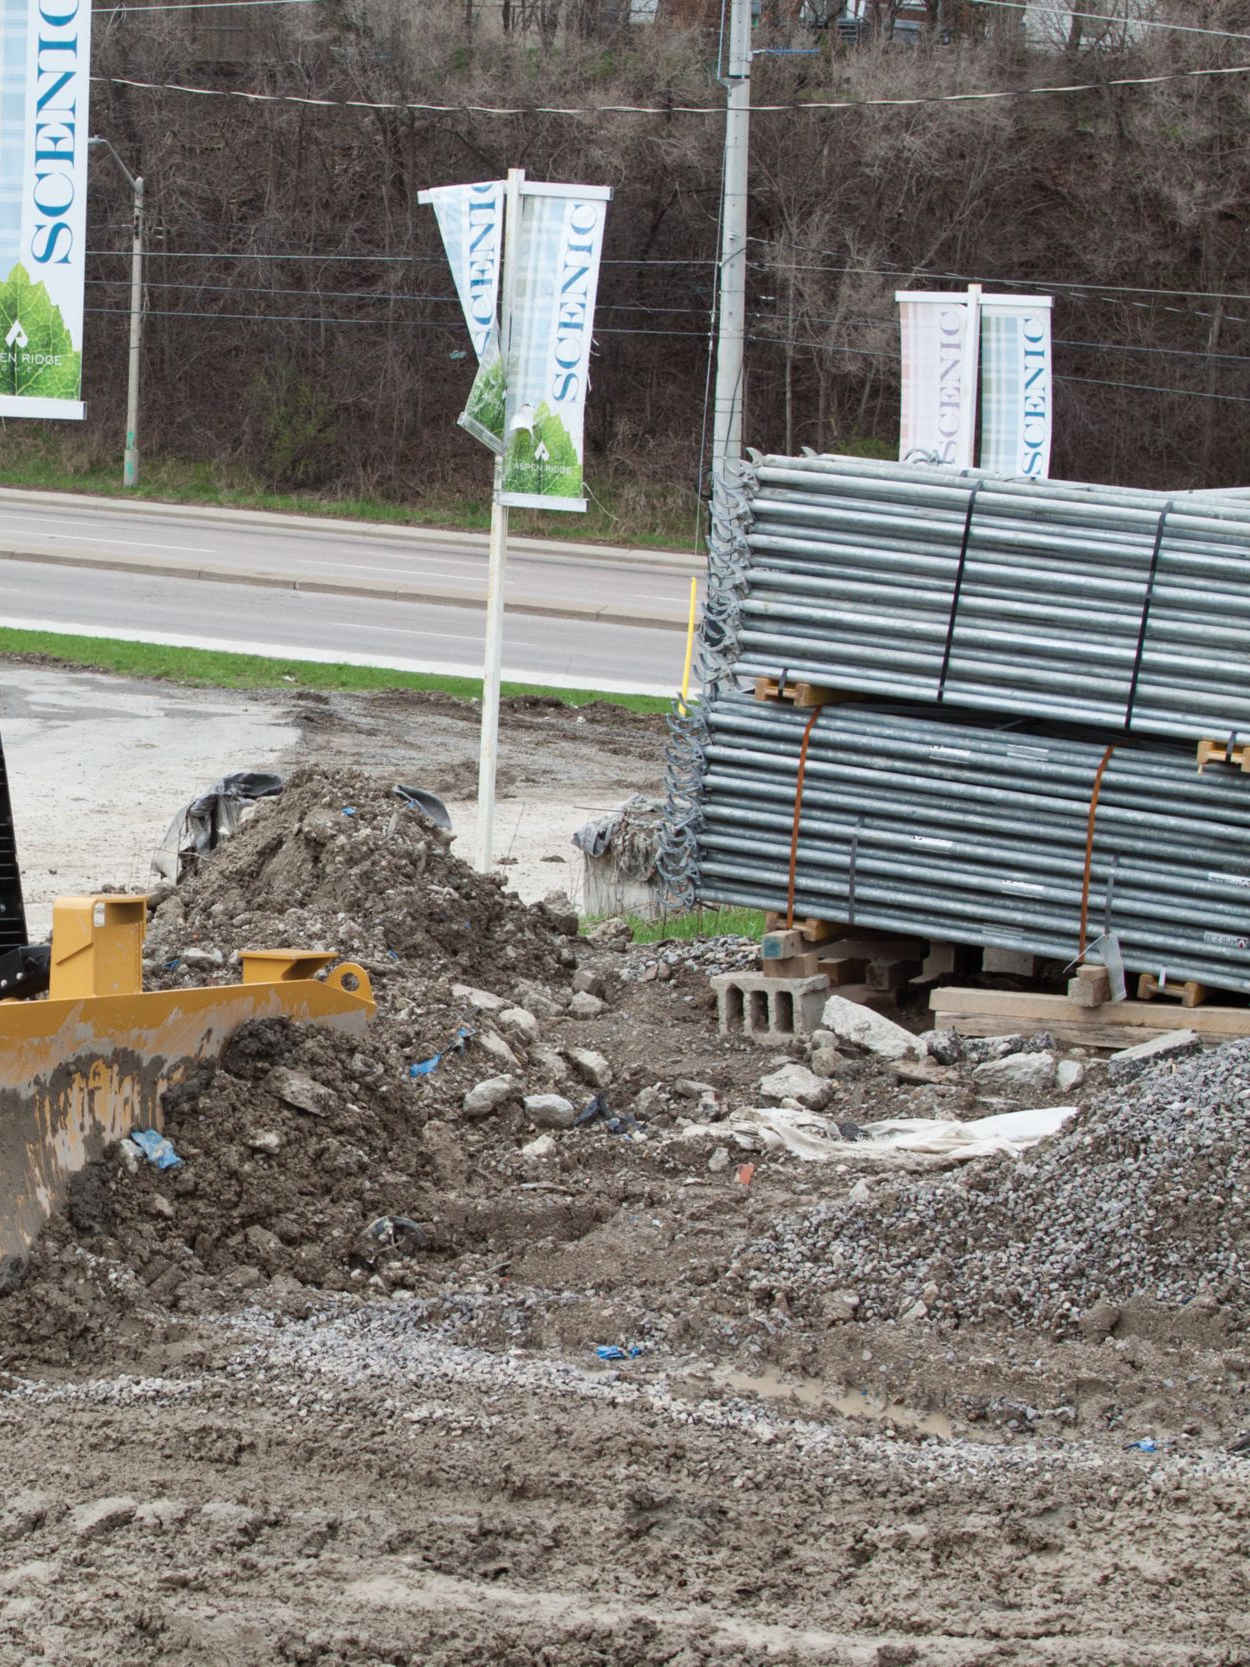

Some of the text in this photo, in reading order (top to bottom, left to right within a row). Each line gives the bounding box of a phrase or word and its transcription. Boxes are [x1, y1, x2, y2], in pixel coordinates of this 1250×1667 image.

[30, 0, 80, 265] SCENIC
[468, 183, 496, 358] SCENI
[551, 203, 598, 403] SCENIC
[21, 353, 63, 366] RIDGE
[938, 311, 962, 464] SCENIC
[1021, 318, 1046, 476] SCENIC
[513, 462, 572, 475] ASPEN RIDGE
